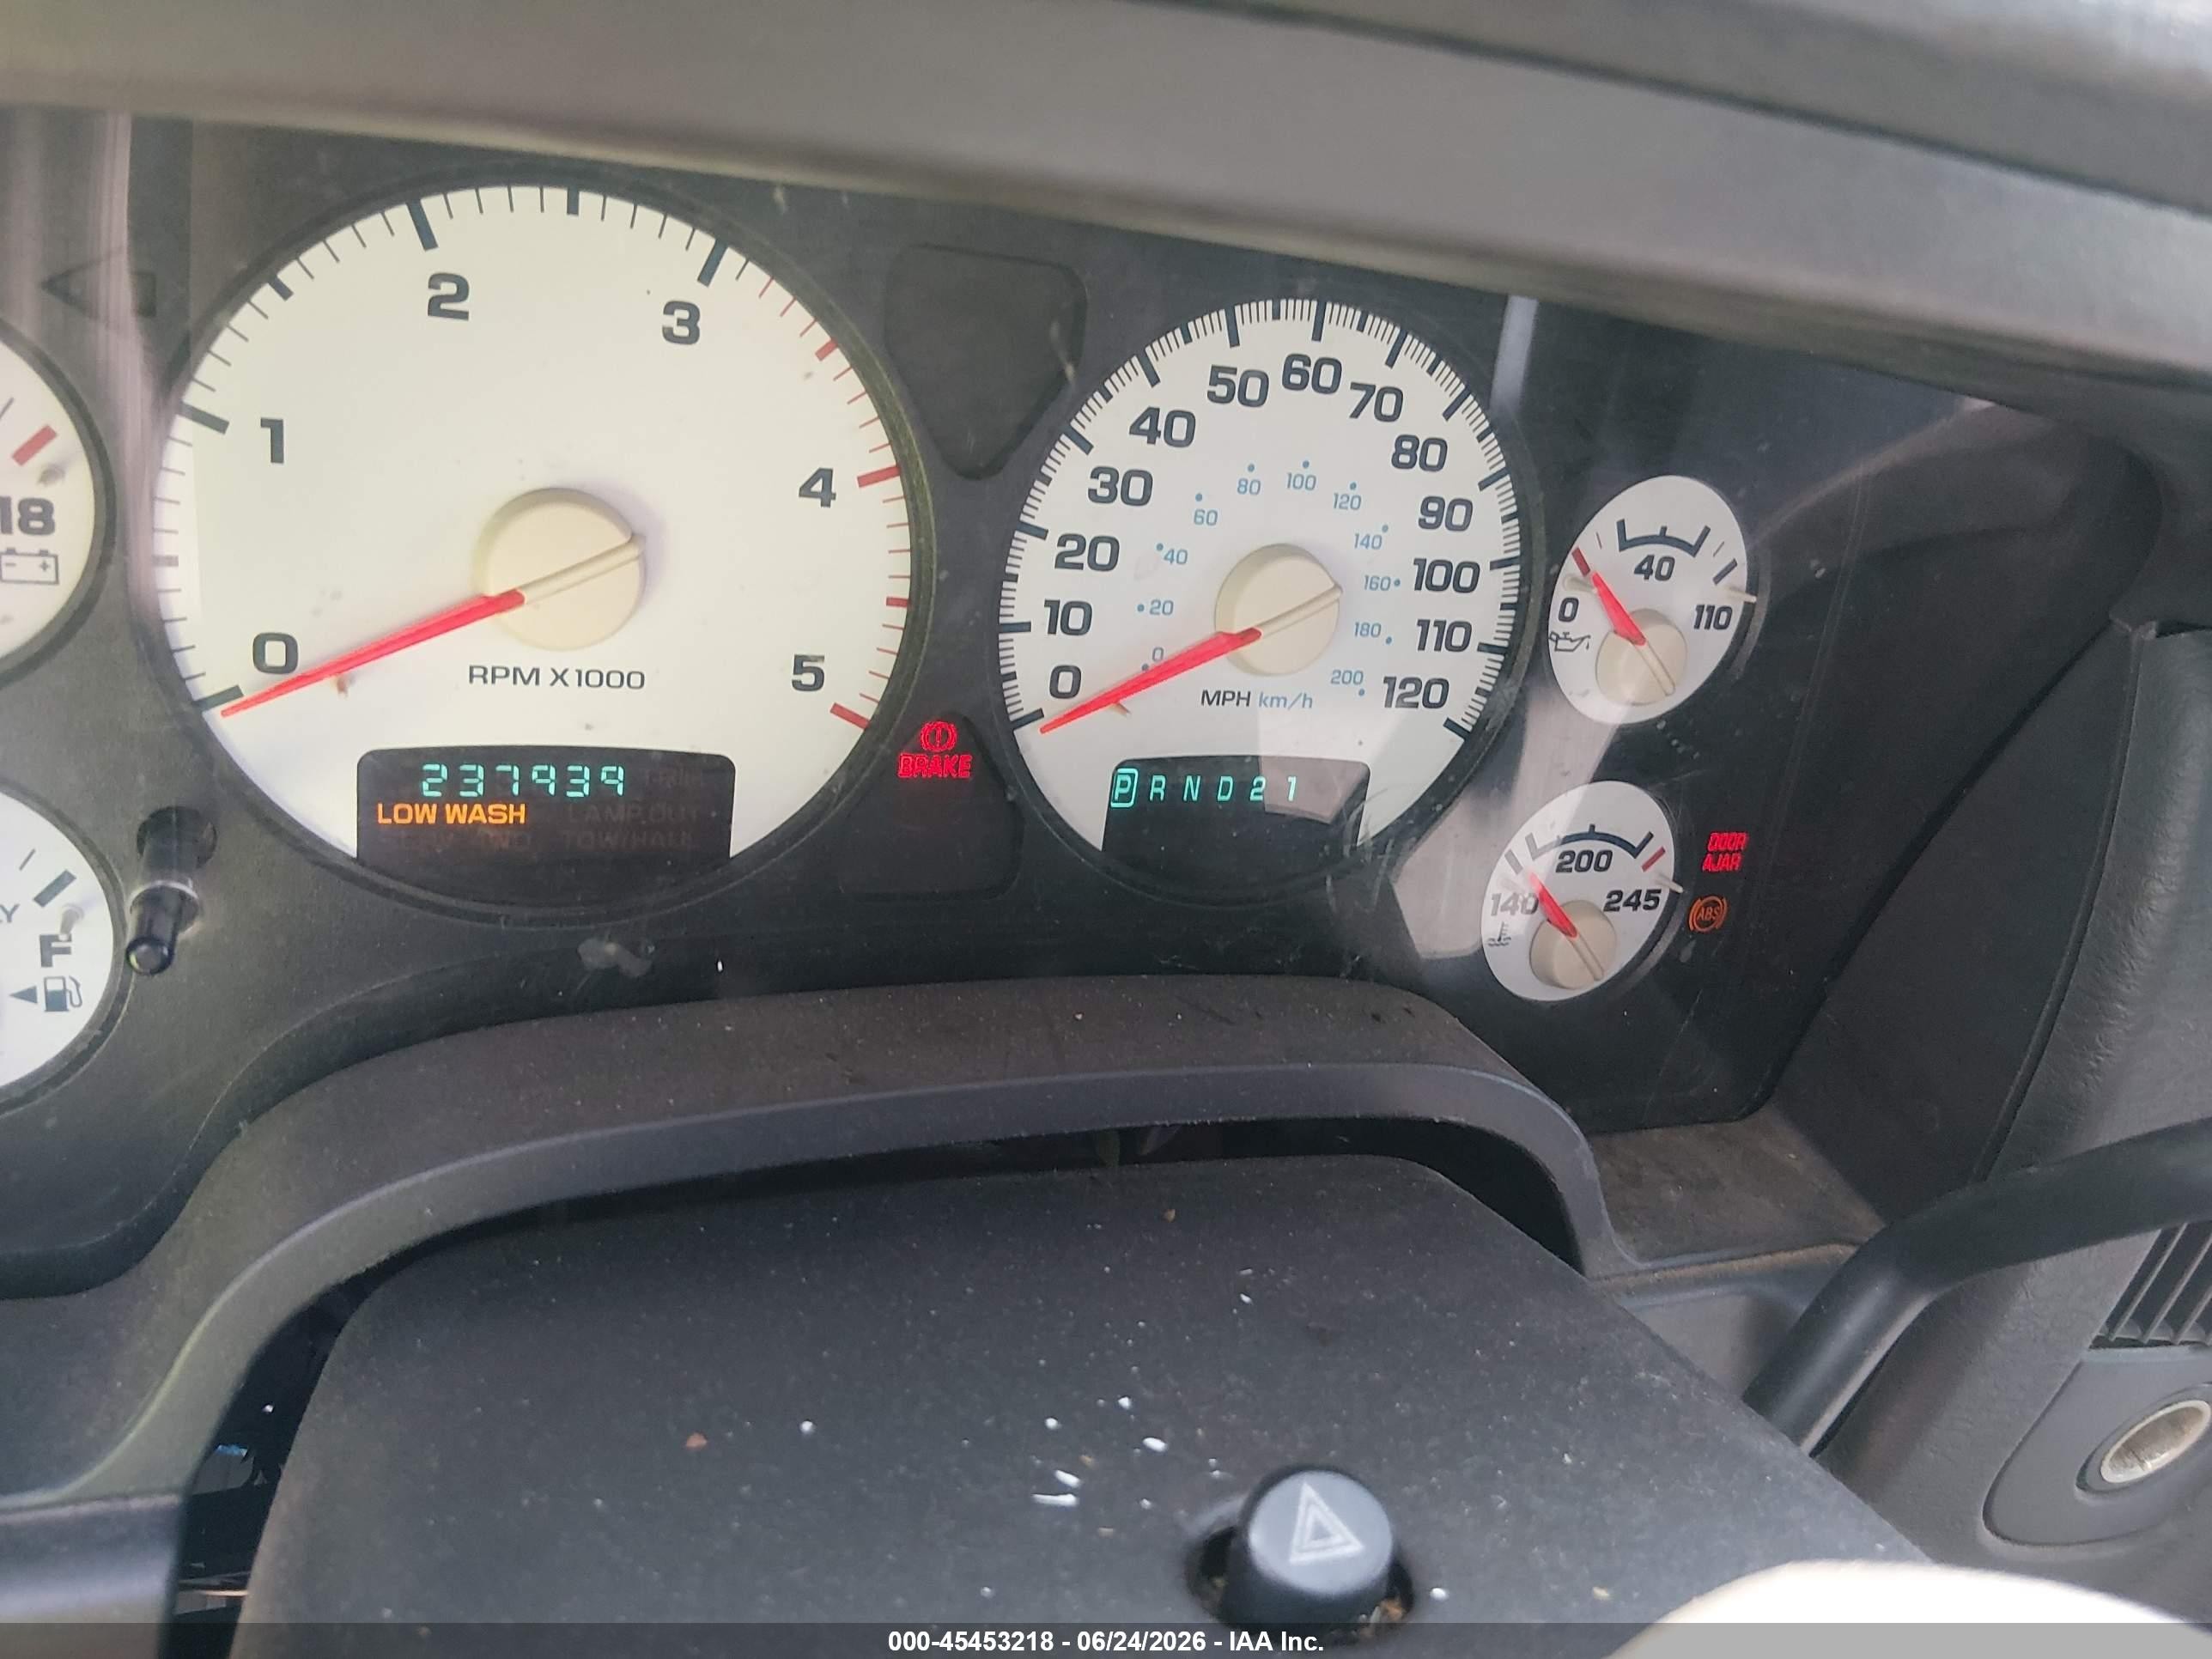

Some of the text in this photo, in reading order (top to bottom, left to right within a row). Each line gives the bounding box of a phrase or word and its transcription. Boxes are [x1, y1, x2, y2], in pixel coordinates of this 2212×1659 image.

[427, 272, 470, 320] 2
[662, 301, 701, 344] 3
[1206, 364, 1269, 408] 50
[1282, 353, 1342, 395] 60
[1349, 381, 1403, 422] 70
[1128, 406, 1195, 447] 40
[260, 418, 284, 464] 1
[1391, 434, 1448, 472] 80
[799, 467, 836, 507] 4
[1088, 466, 1153, 507] 30
[1237, 478, 1261, 495] 80
[1286, 472, 1316, 491] 100
[0, 496, 55, 535] 18
[1333, 493, 1362, 511] 120
[1419, 496, 1473, 532] 90
[1194, 509, 1218, 526] 60
[1054, 533, 1120, 572] 20
[1354, 533, 1382, 550] 140
[1164, 549, 1188, 565] 40
[1633, 555, 1675, 581] 40
[1364, 575, 1391, 591] 160
[1413, 558, 1480, 593] 100
[1044, 599, 1092, 636] 10
[1149, 600, 1174, 615] 20
[1558, 597, 1579, 623] 0
[1693, 604, 1733, 630] 110
[1354, 622, 1382, 638] 180
[1417, 619, 1472, 653] 110
[252, 632, 299, 674] 0
[1152, 647, 1164, 662] 0
[469, 665, 540, 686] RPM
[792, 654, 825, 691] 5
[1049, 665, 1081, 699] 0
[1330, 670, 1364, 685] 200
[1200, 690, 1314, 709] MPH km/h
[1382, 676, 1449, 709] 120
[898, 753, 972, 778] BRAKE
[422, 763, 624, 798] 237939
[1115, 774, 1297, 802] P R N D 2 1
[377, 803, 526, 824] LOW WASH
[1555, 849, 1613, 873] 200
[1702, 853, 1742, 872] AJAR
[1490, 893, 1539, 916] 140
[1602, 889, 1662, 912] 245
[1697, 906, 1720, 921] ABS
[40, 934, 72, 968] F
